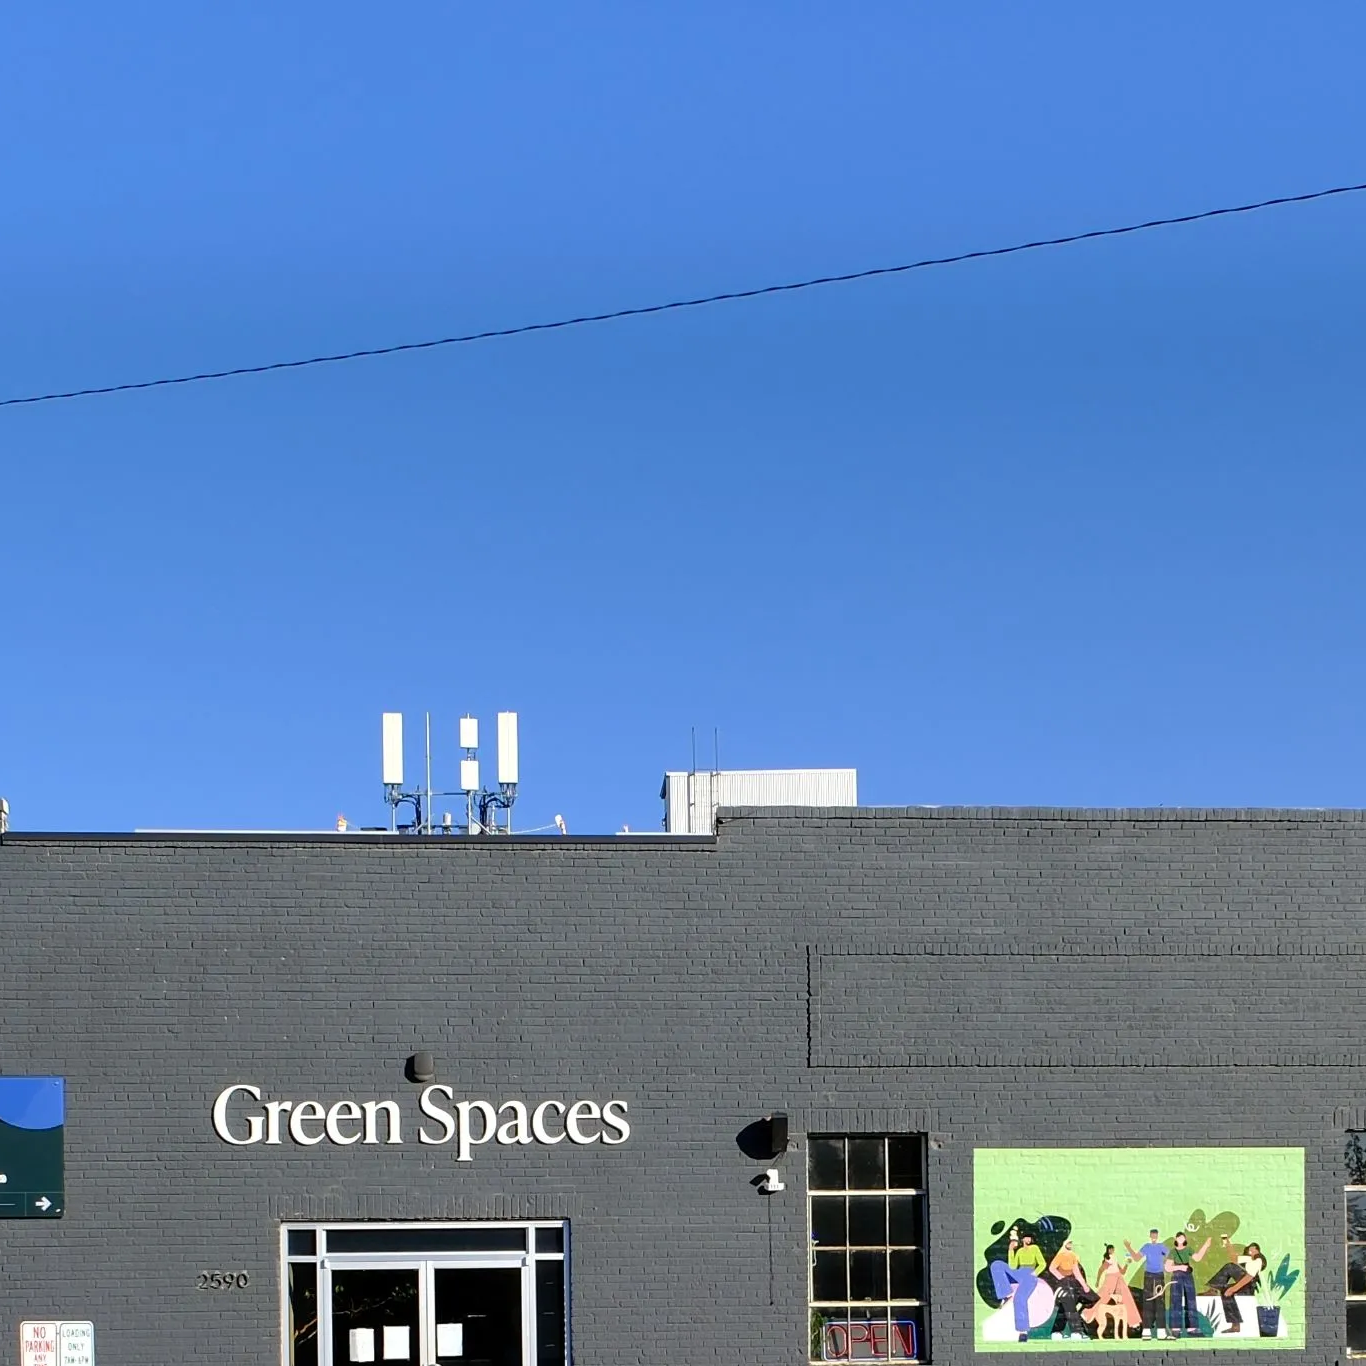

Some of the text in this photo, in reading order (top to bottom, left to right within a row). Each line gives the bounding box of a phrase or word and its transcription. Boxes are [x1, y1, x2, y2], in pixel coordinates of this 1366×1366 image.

[212, 1084, 631, 1162] Green Spaces
[197, 1272, 249, 1290] 2590
[33, 1326, 47, 1339] NO
[62, 1328, 90, 1338] LOADING
[25, 1340, 55, 1353] PARKING
[67, 1342, 85, 1351] ONLY
[826, 1324, 913, 1358] OPEN
[34, 1354, 47, 1363] ANY
